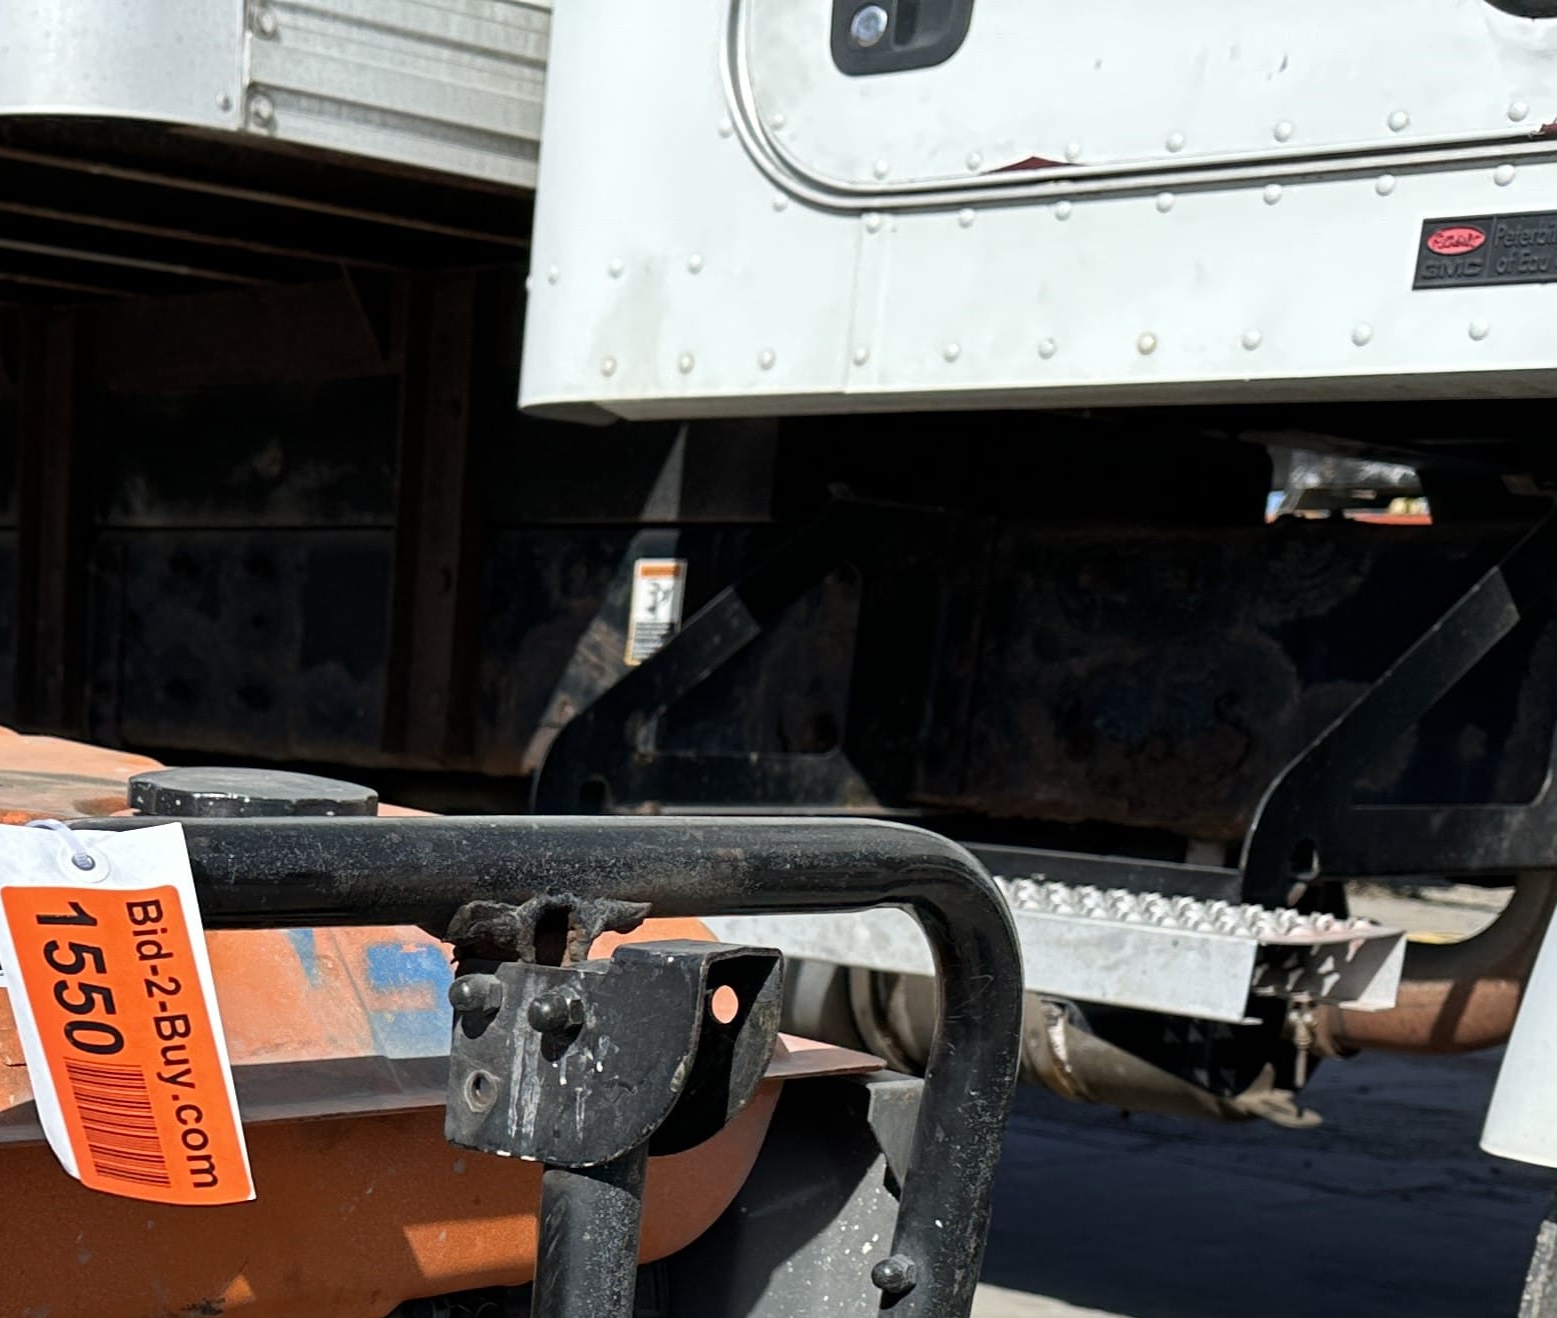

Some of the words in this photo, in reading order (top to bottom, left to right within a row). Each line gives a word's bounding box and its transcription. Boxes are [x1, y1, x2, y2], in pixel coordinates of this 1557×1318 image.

[1422, 258, 1483, 279] GMC
[35, 900, 125, 1056] 1550
[126, 898, 220, 1190] Bid-2-Buy.com
